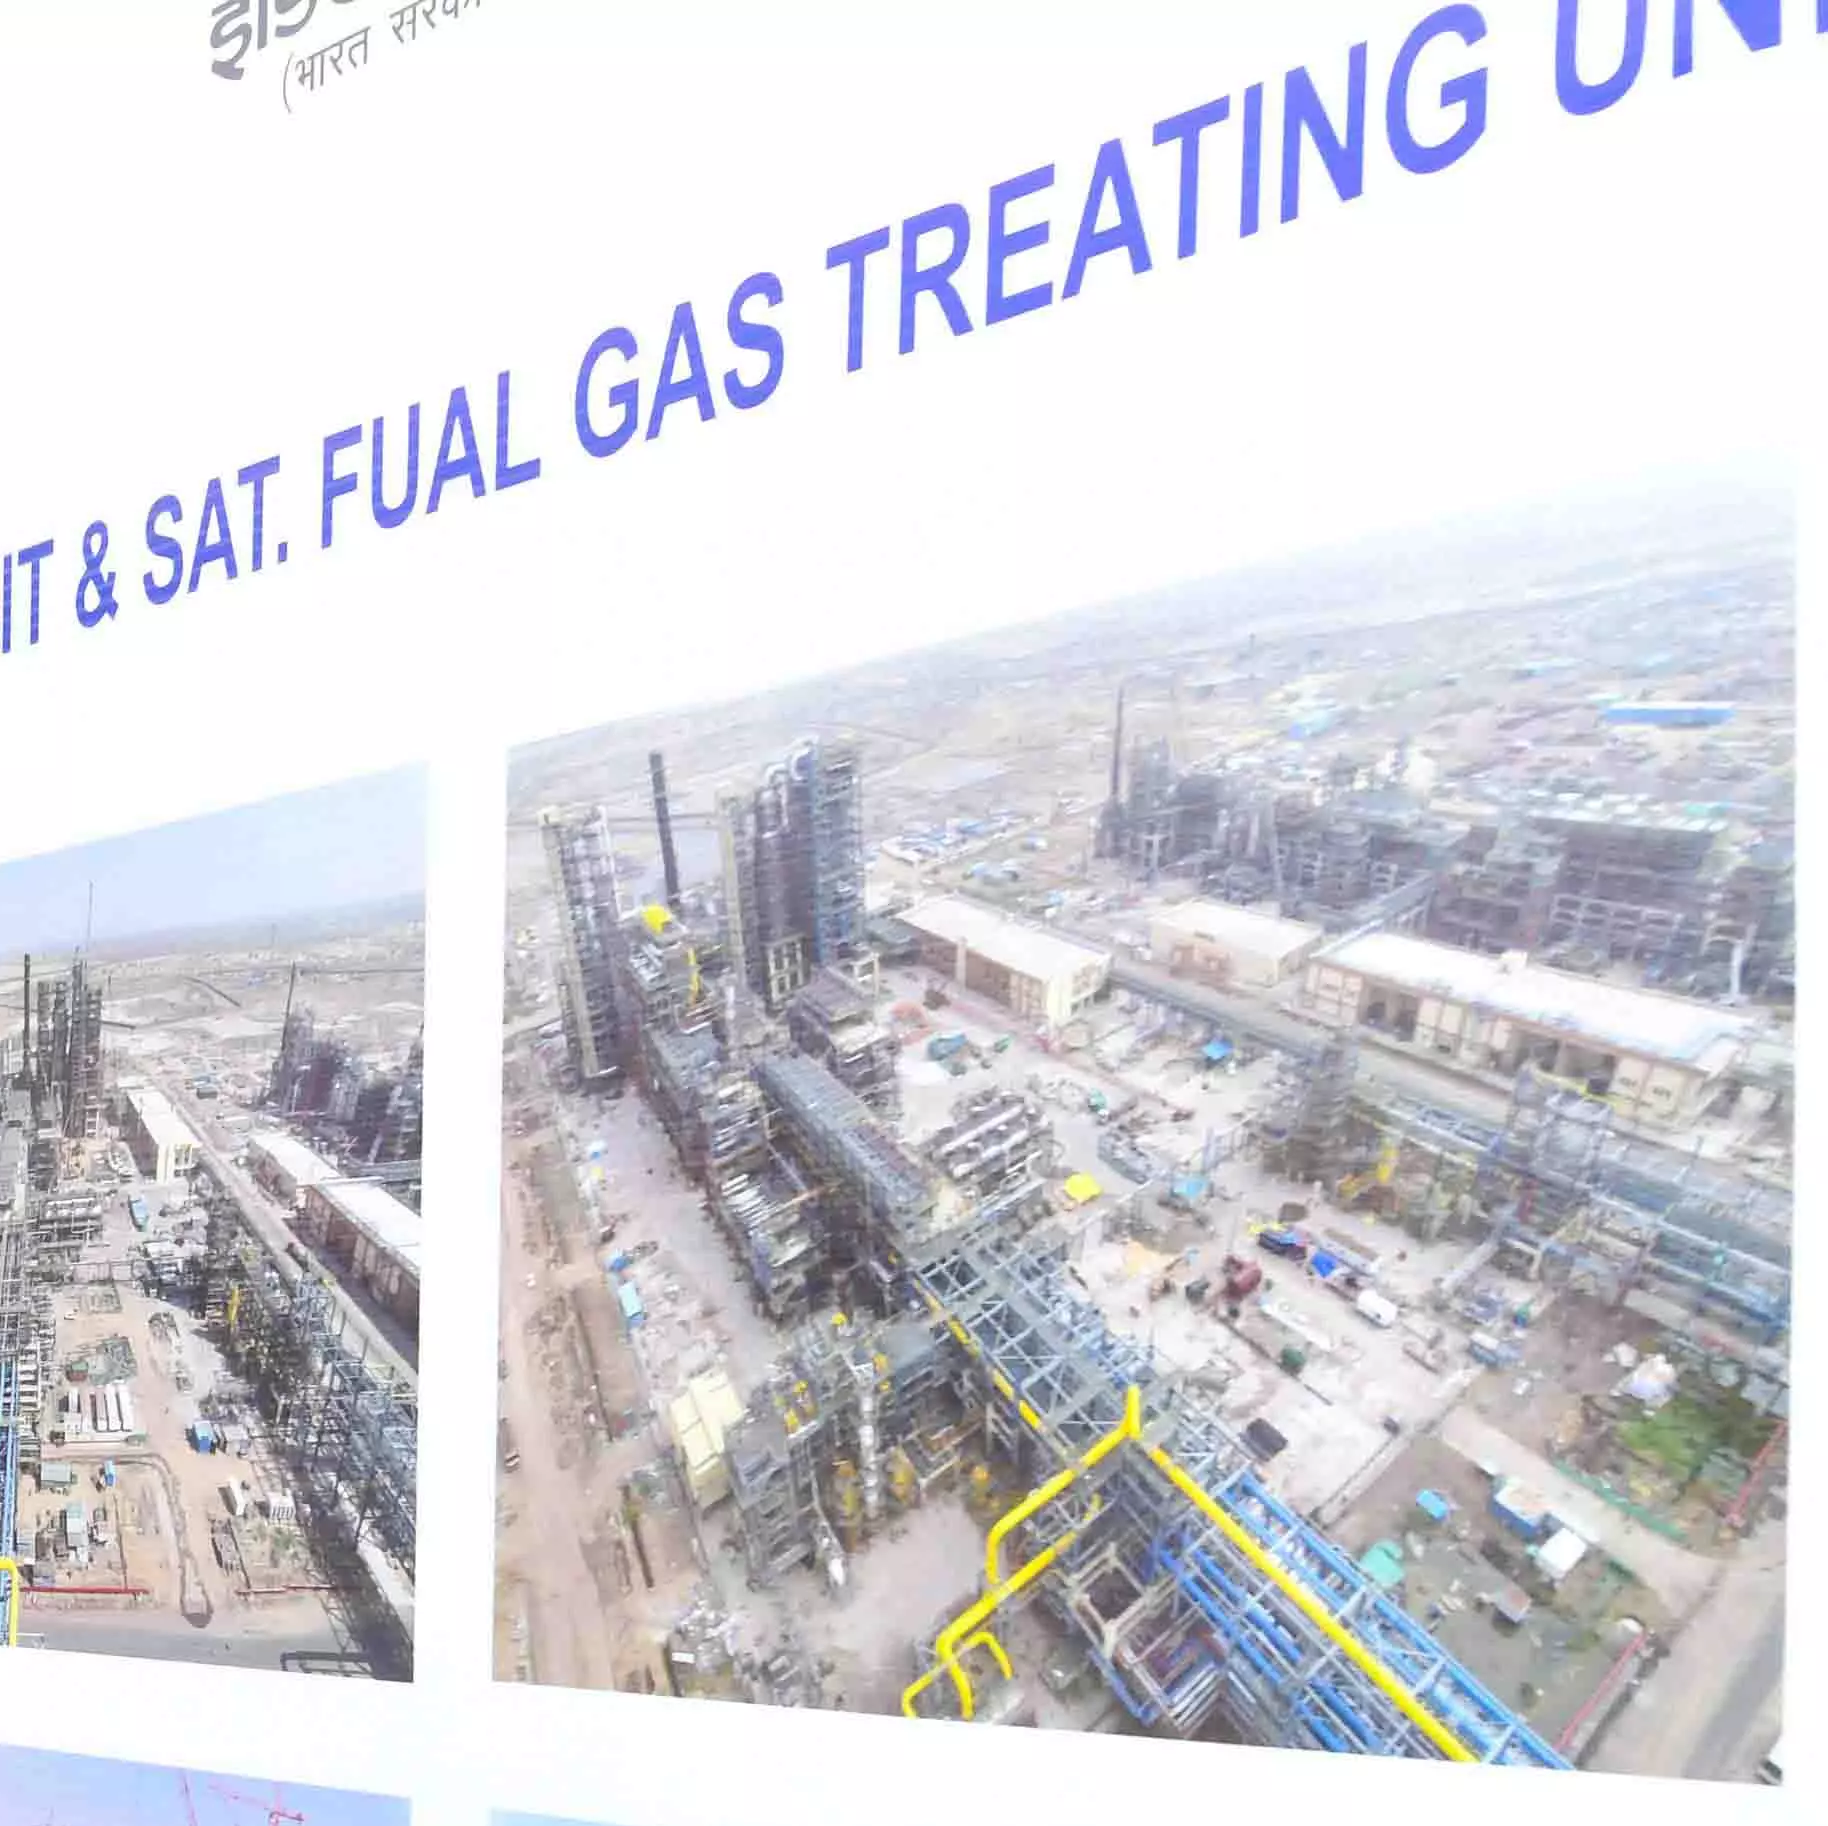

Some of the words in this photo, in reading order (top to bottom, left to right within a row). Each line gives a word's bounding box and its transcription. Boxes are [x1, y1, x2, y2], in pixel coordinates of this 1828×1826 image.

[282, 26, 372, 114] (भारत
[74, 520, 118, 627] &
[143, 455, 289, 605] SAT.
[320, 370, 542, 548] FUAL
[574, 270, 785, 460] GAS
[824, 2, 1490, 373] TREATING
